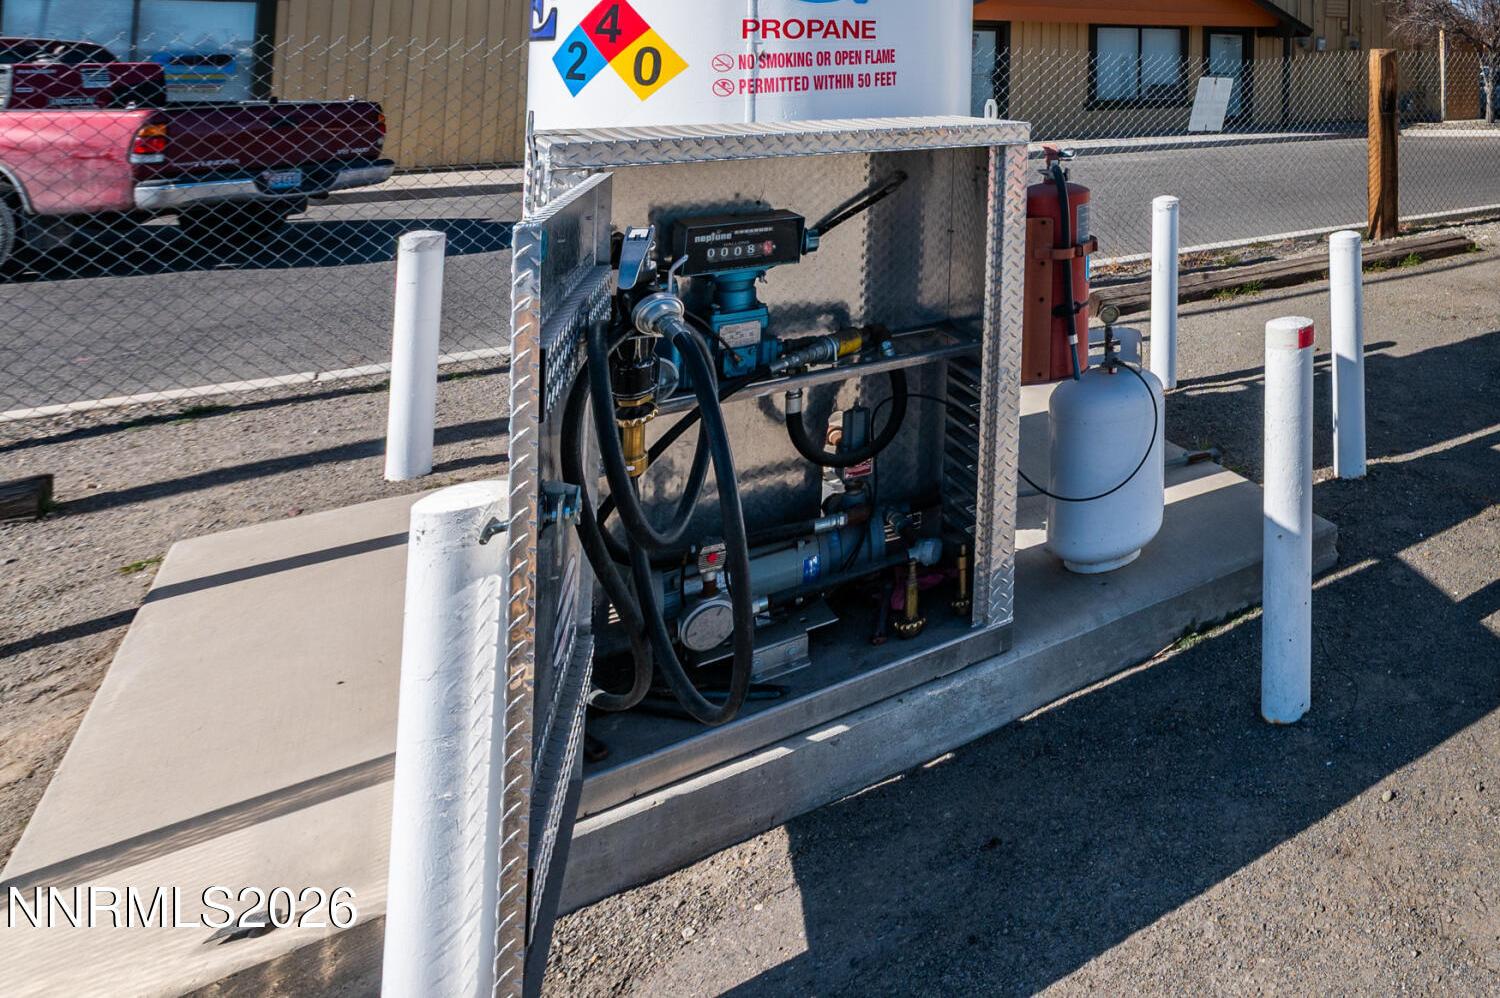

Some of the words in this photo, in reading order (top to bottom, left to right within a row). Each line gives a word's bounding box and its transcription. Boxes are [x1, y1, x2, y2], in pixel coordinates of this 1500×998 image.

[595, 4, 622, 43] 4
[742, 18, 877, 40] PROPANE
[565, 41, 588, 81] 2
[633, 46, 662, 87] 0
[738, 53, 755, 70] NO
[759, 51, 813, 69] SMOKING
[816, 51, 832, 67] OR
[834, 49, 862, 66] OPEN
[865, 48, 896, 65] FLAME
[738, 75, 809, 95] PERMITTED
[813, 73, 854, 90] WITHIN
[858, 72, 871, 88] 50
[874, 71, 897, 87] FEET
[694, 232, 732, 243] neptune
